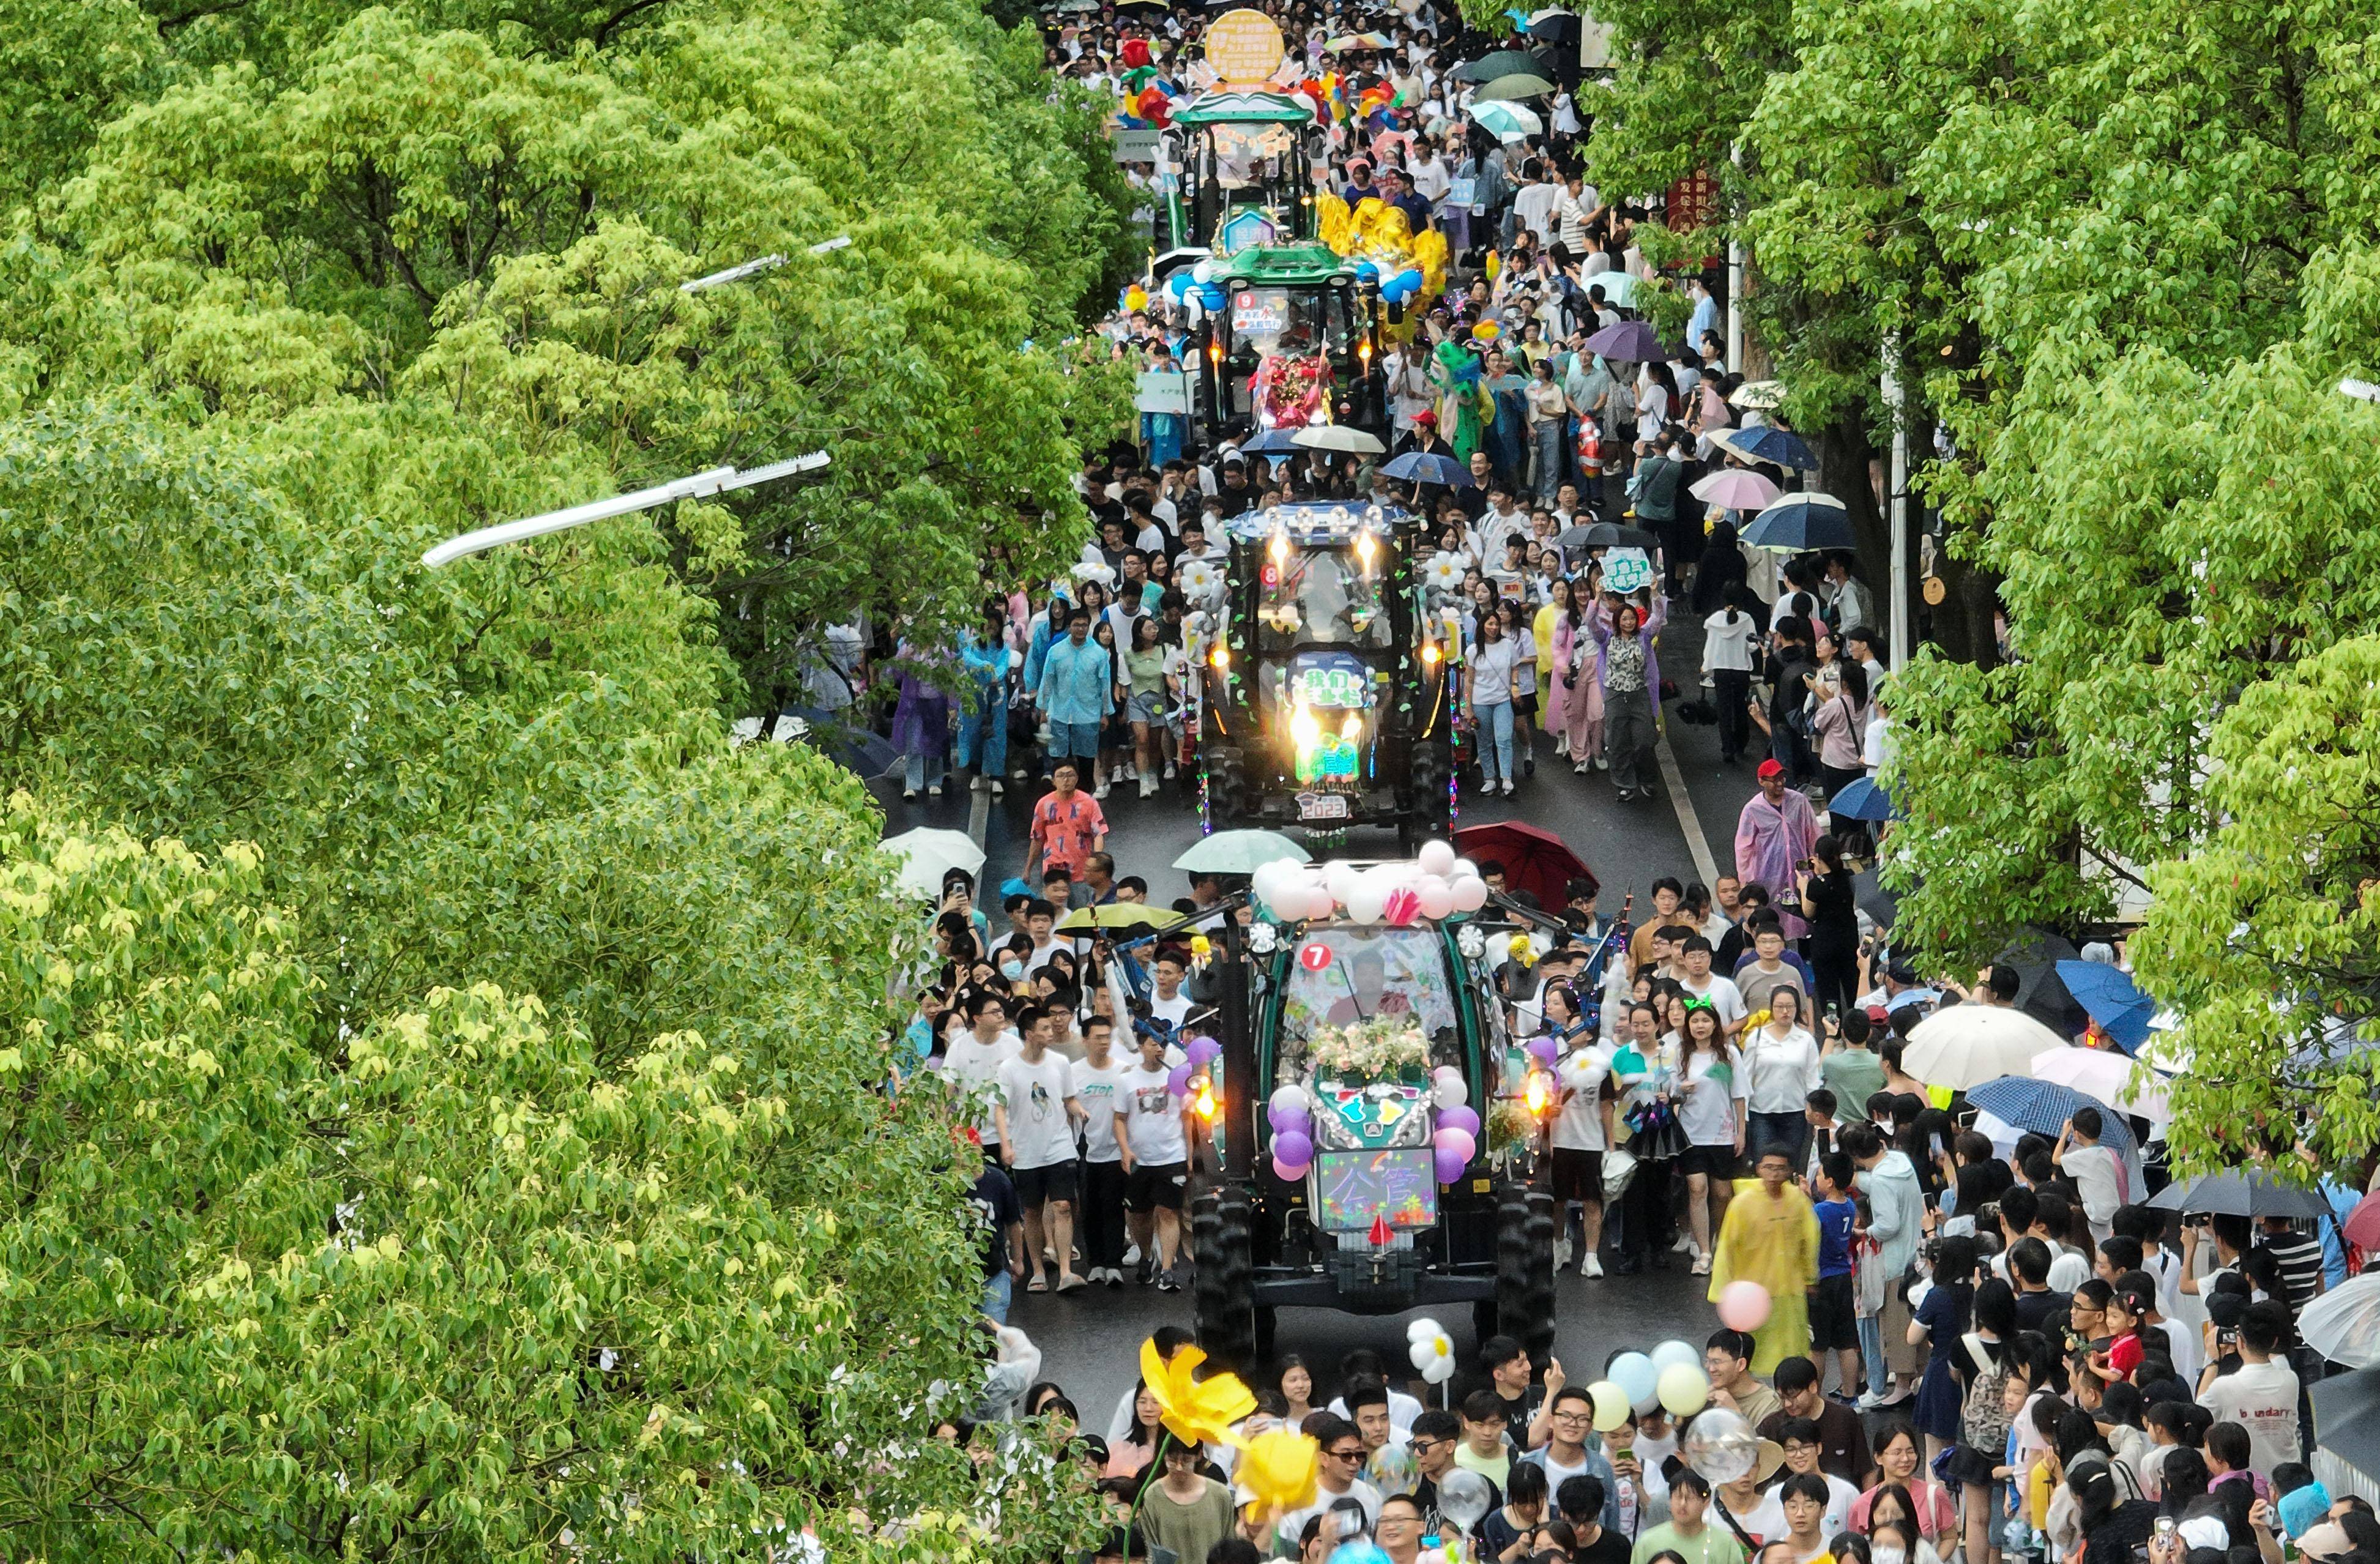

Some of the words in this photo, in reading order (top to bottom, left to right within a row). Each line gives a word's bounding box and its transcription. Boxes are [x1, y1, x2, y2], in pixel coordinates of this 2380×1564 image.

[1241, 295, 1251, 308] 9
[1265, 567, 1277, 582] 8
[1306, 670, 1348, 688] 我们
[1304, 803, 1344, 817] 2023
[1311, 947, 1323, 966] 7
[1327, 1166, 1421, 1205] 公管
[1843, 1216, 1850, 1234] 7
